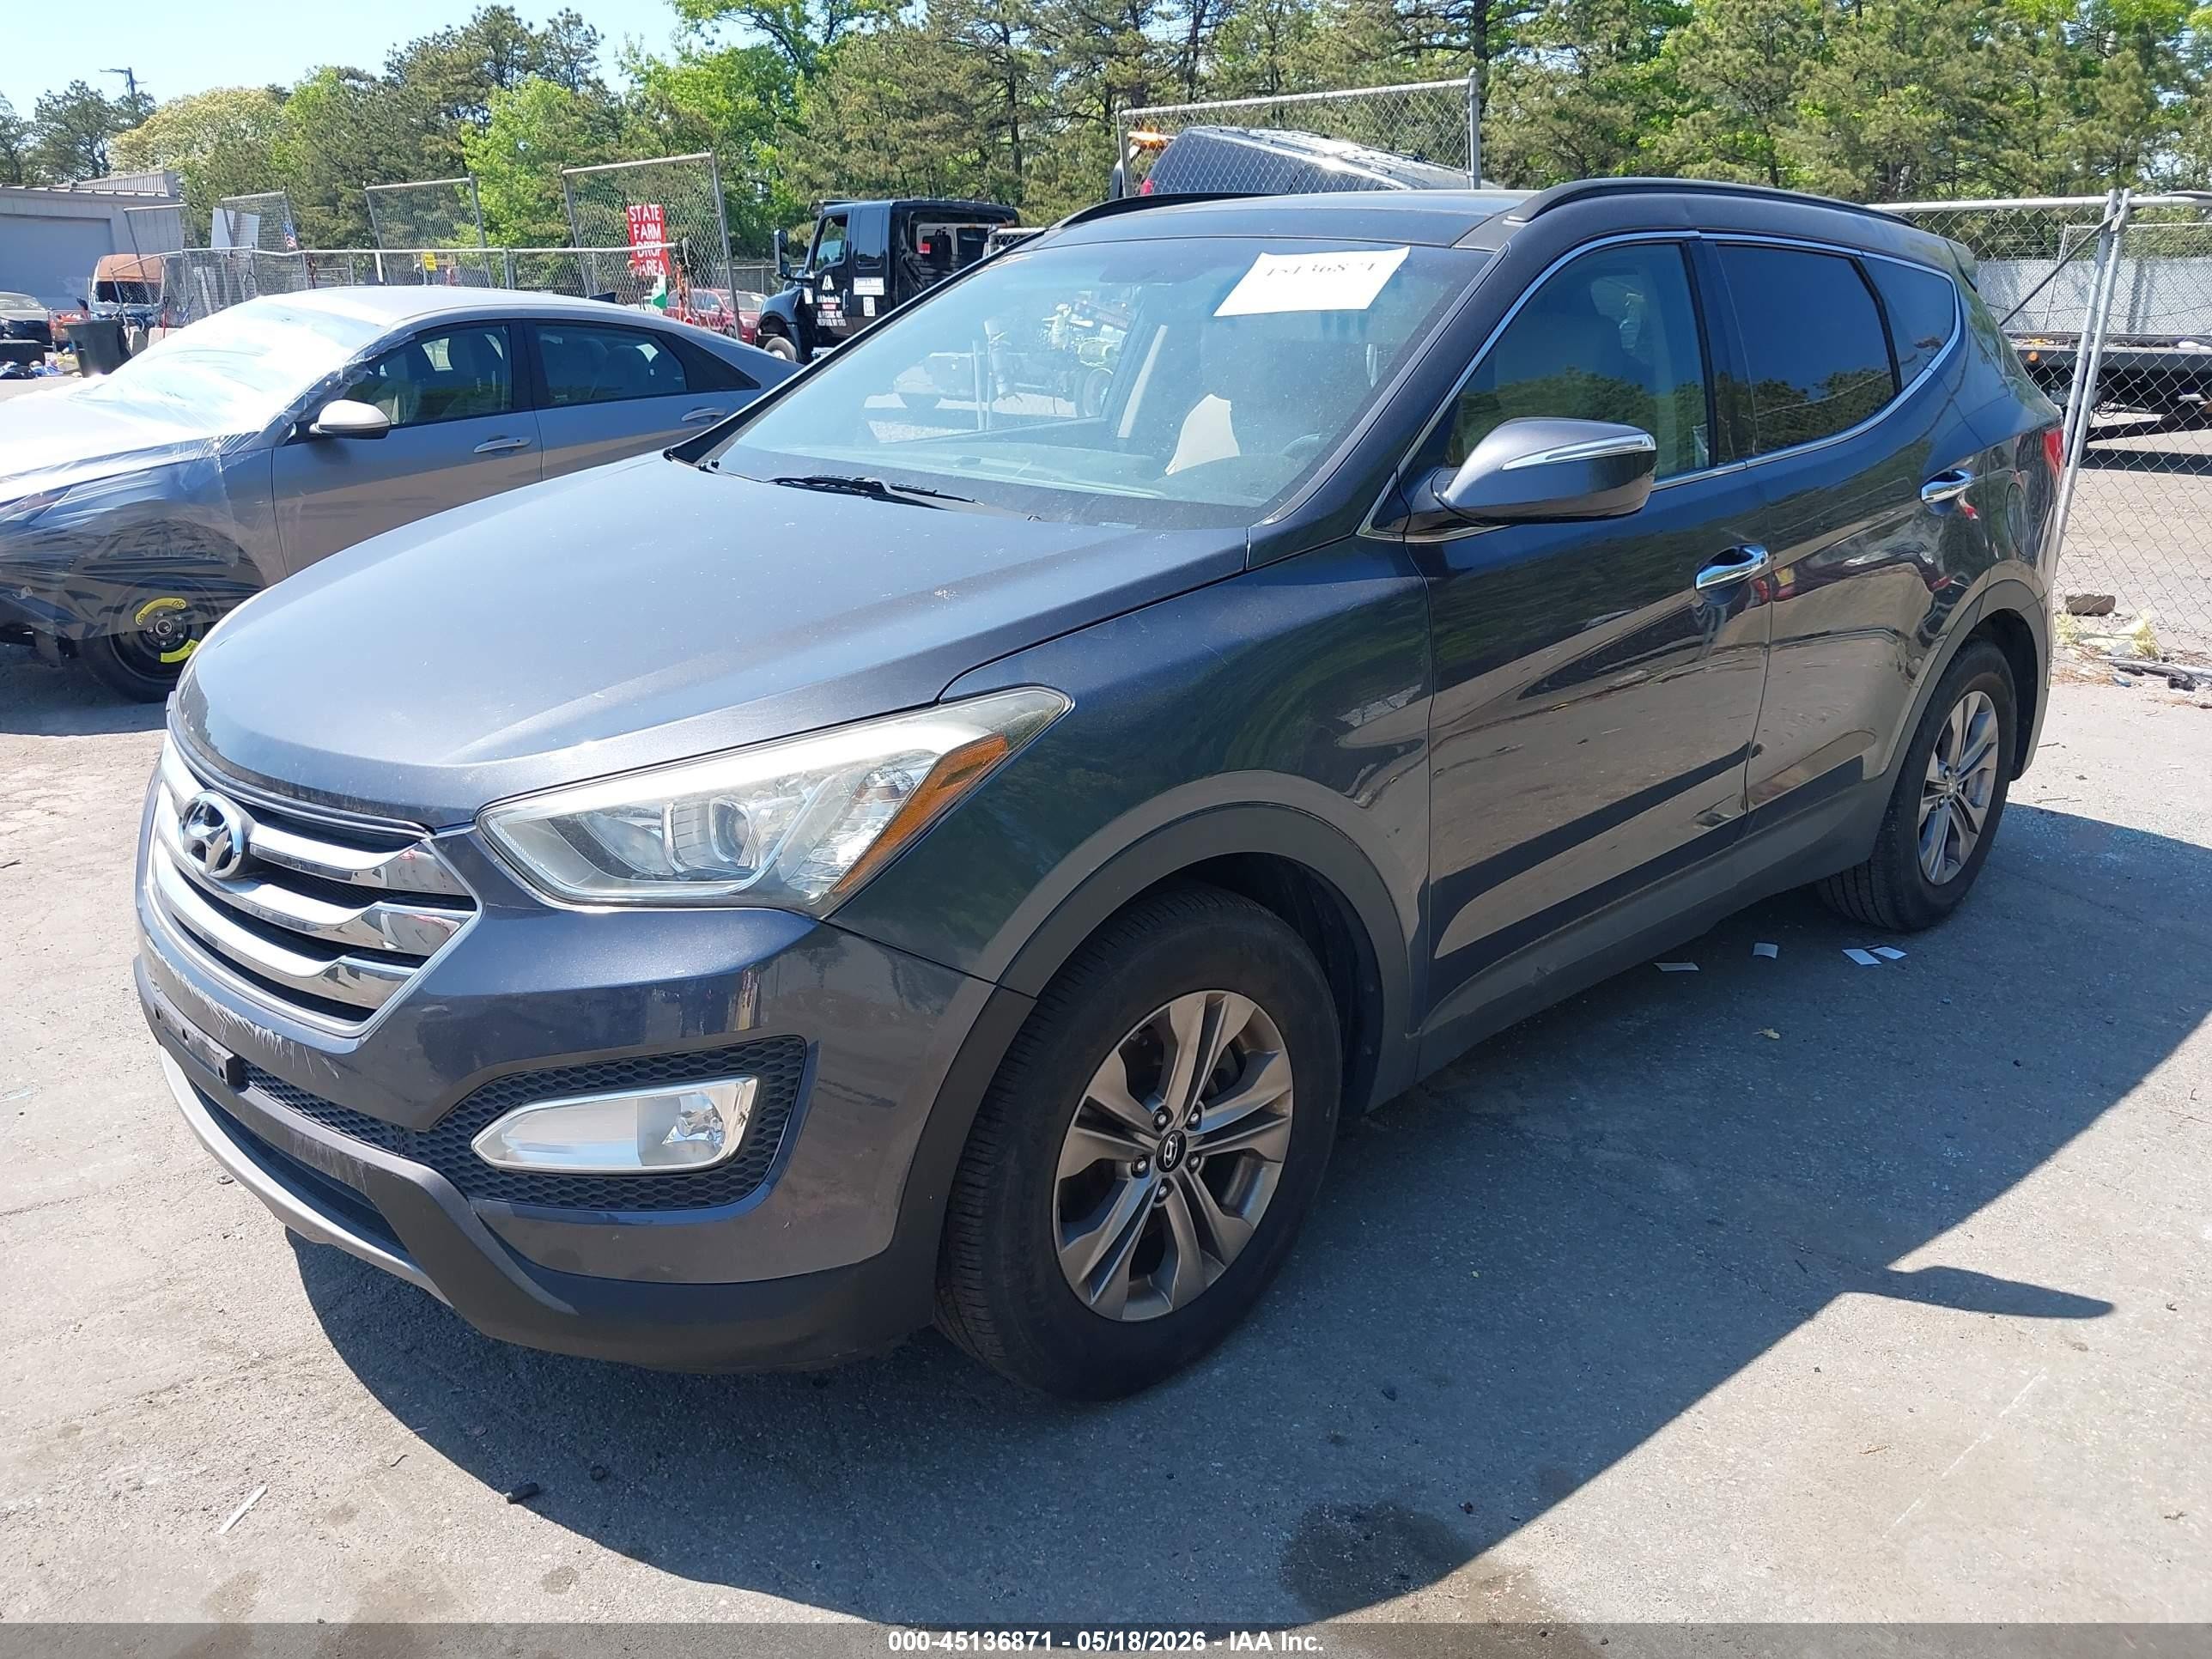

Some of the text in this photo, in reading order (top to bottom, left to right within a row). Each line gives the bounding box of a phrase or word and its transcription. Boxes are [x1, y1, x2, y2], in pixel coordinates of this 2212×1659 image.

[629, 204, 661, 222] STATE
[633, 222, 662, 240] FARM
[635, 240, 662, 258] DROP
[638, 259, 666, 276] AREA
